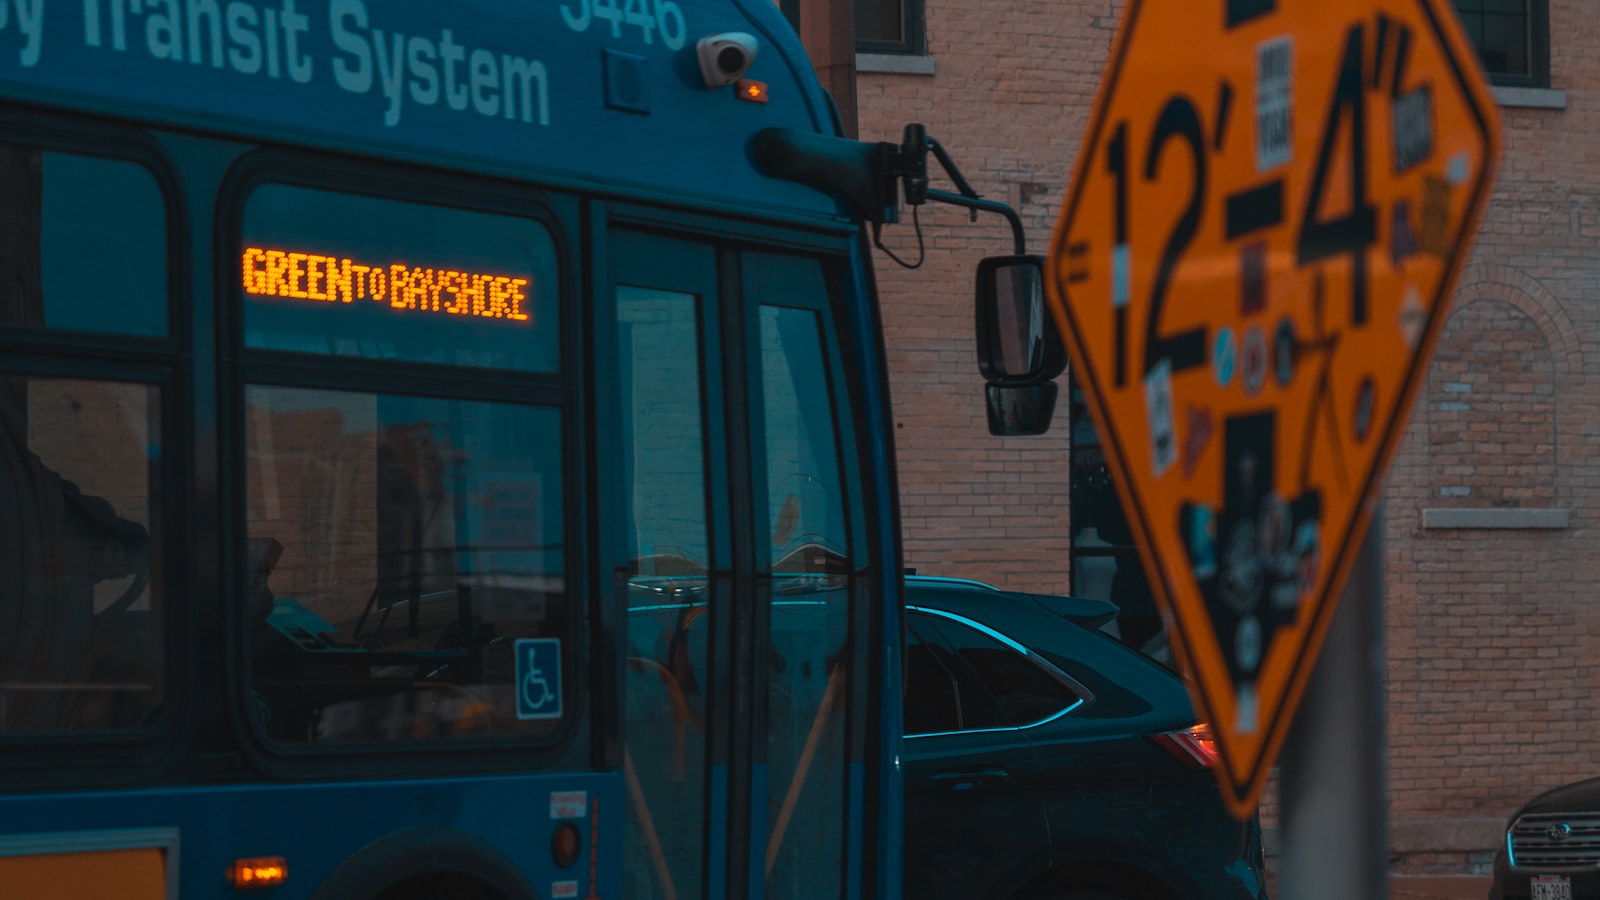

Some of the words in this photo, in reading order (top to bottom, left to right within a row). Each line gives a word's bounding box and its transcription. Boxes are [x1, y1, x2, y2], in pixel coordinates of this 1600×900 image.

[0, 0, 43, 67] y
[330, 0, 549, 126] System
[242, 247, 352, 303] GREEN
[351, 264, 386, 301] TO
[390, 264, 528, 321] BAYSHORE
